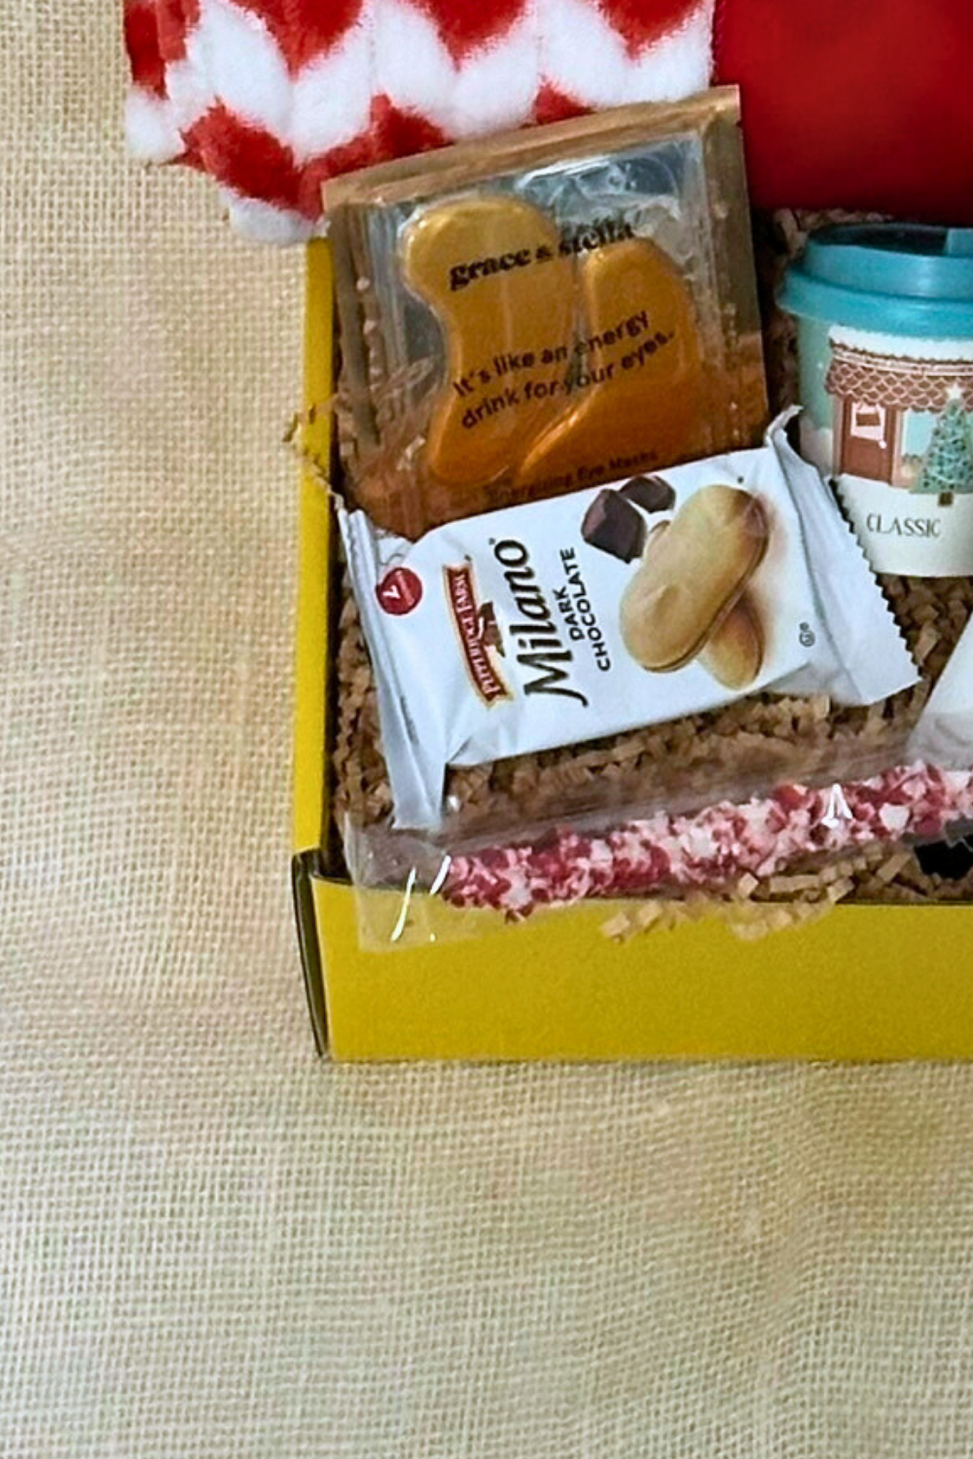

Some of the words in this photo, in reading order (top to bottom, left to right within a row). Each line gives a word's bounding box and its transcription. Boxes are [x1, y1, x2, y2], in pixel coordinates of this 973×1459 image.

[450, 248, 531, 291] grace
[536, 244, 553, 263] &
[452, 369, 491, 397] It's
[493, 352, 535, 376] like
[541, 344, 568, 364] an
[574, 310, 649, 356] energy
[462, 387, 520, 429] drink
[524, 380, 559, 401] for
[561, 362, 615, 396] your
[621, 330, 675, 371] eyes.
[866, 513, 942, 538] CLASSIC
[493, 539, 589, 708] Milano
[552, 586, 586, 641] DARK
[560, 547, 611, 672] CHOCOLATE
